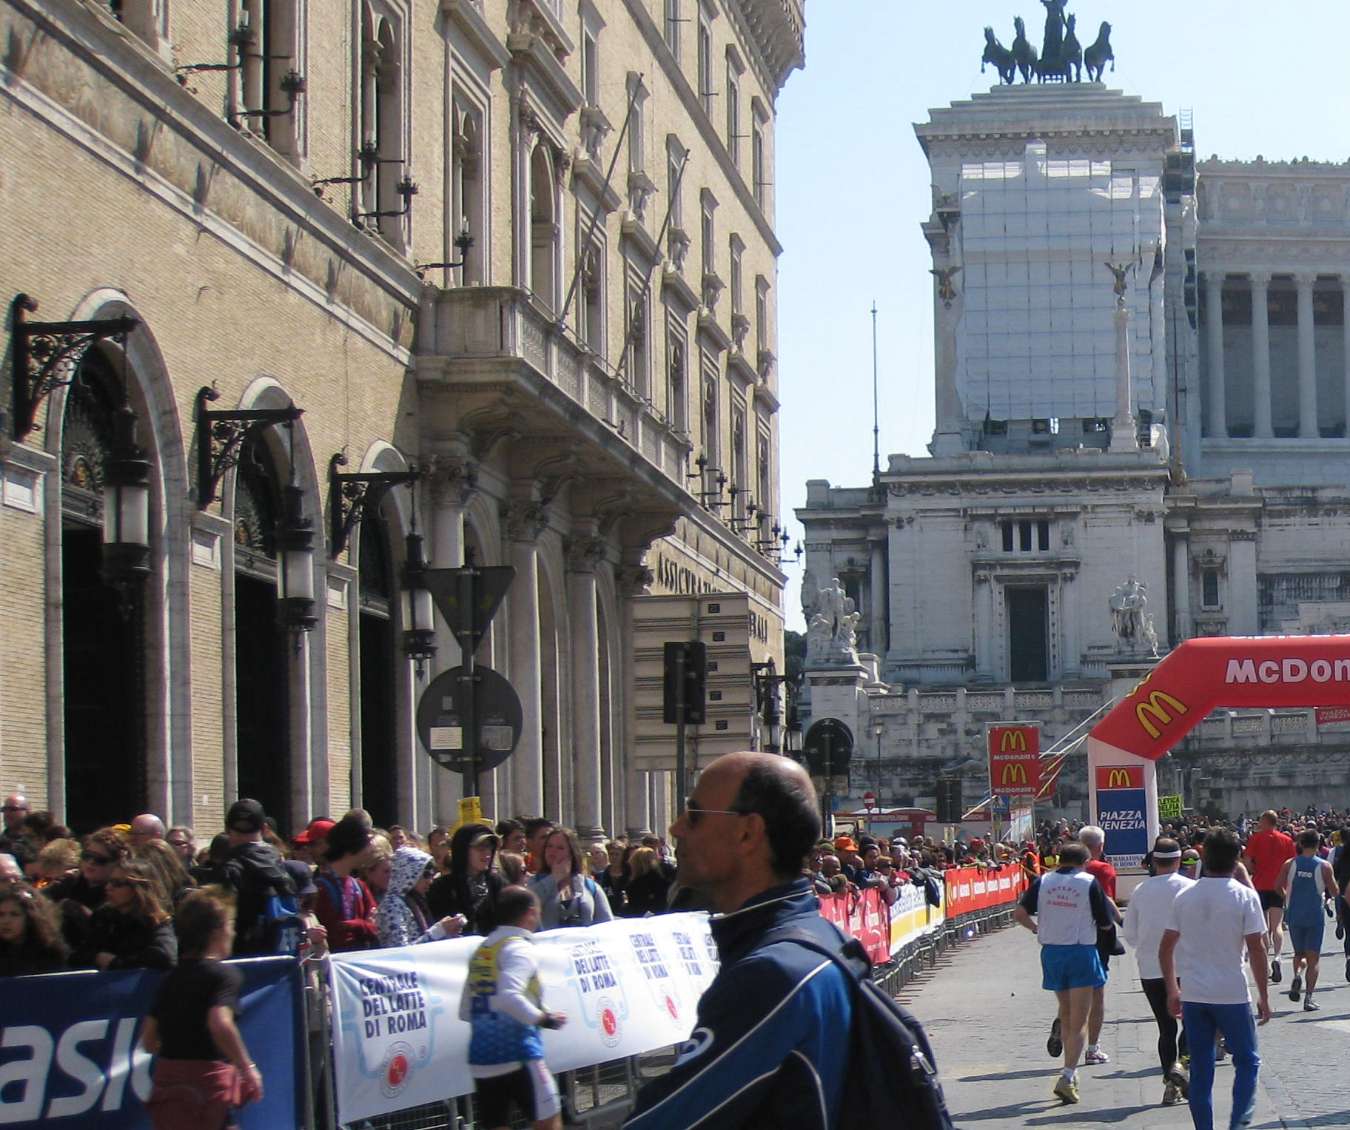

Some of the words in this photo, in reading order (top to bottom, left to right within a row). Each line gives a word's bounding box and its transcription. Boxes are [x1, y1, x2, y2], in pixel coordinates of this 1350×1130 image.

[658, 551, 723, 594] ASSICVRA
[1099, 820, 1146, 830] VENEZIA
[1100, 811, 1142, 821] PIAZZA
[574, 957, 591, 975] DEL
[591, 955, 611, 974] LATTE
[579, 975, 592, 993] DI
[593, 971, 617, 990] ROMA
[363, 996, 388, 1018] DEL
[387, 991, 425, 1013] LATTE
[364, 1019, 381, 1039] DI
[387, 1011, 427, 1035] ROMA
